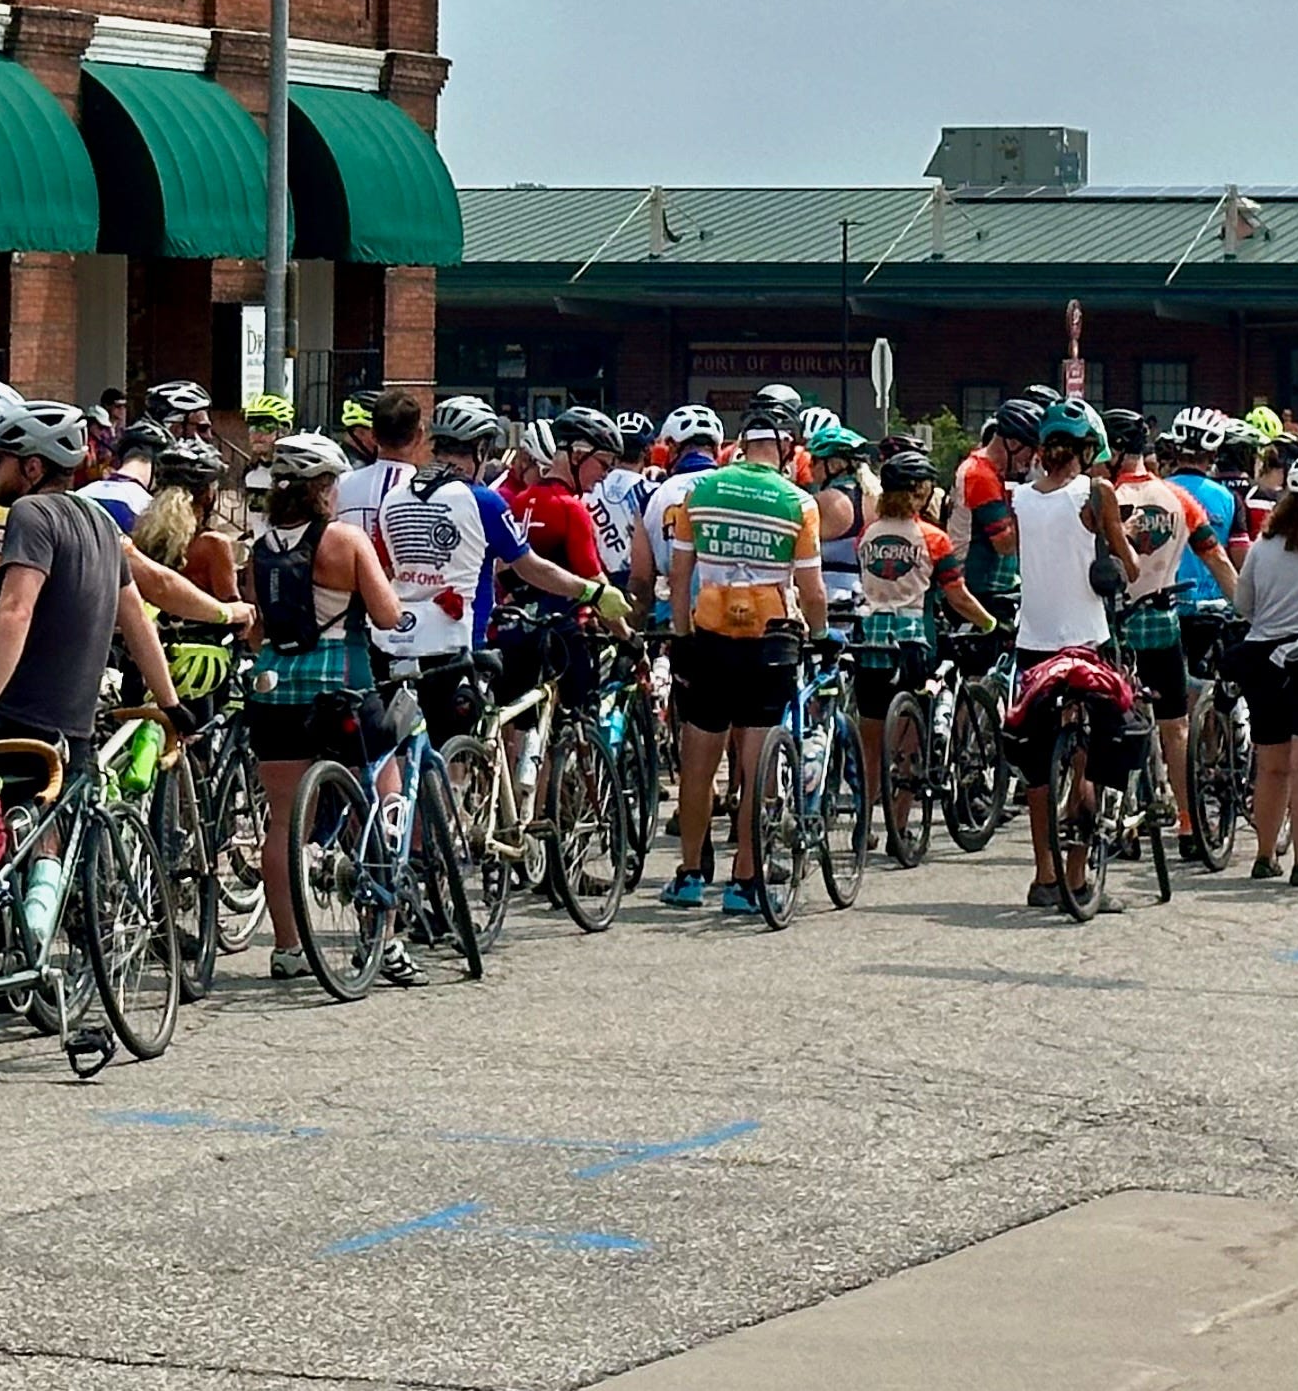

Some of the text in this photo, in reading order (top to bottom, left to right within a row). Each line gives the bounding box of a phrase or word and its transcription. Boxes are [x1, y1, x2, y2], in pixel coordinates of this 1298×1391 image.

[693, 355, 868, 373] PORT OF BURLINGT
[585, 498, 627, 554] JDRF
[701, 523, 785, 548] ST PADDY
[861, 541, 923, 569] RAGBRAI
